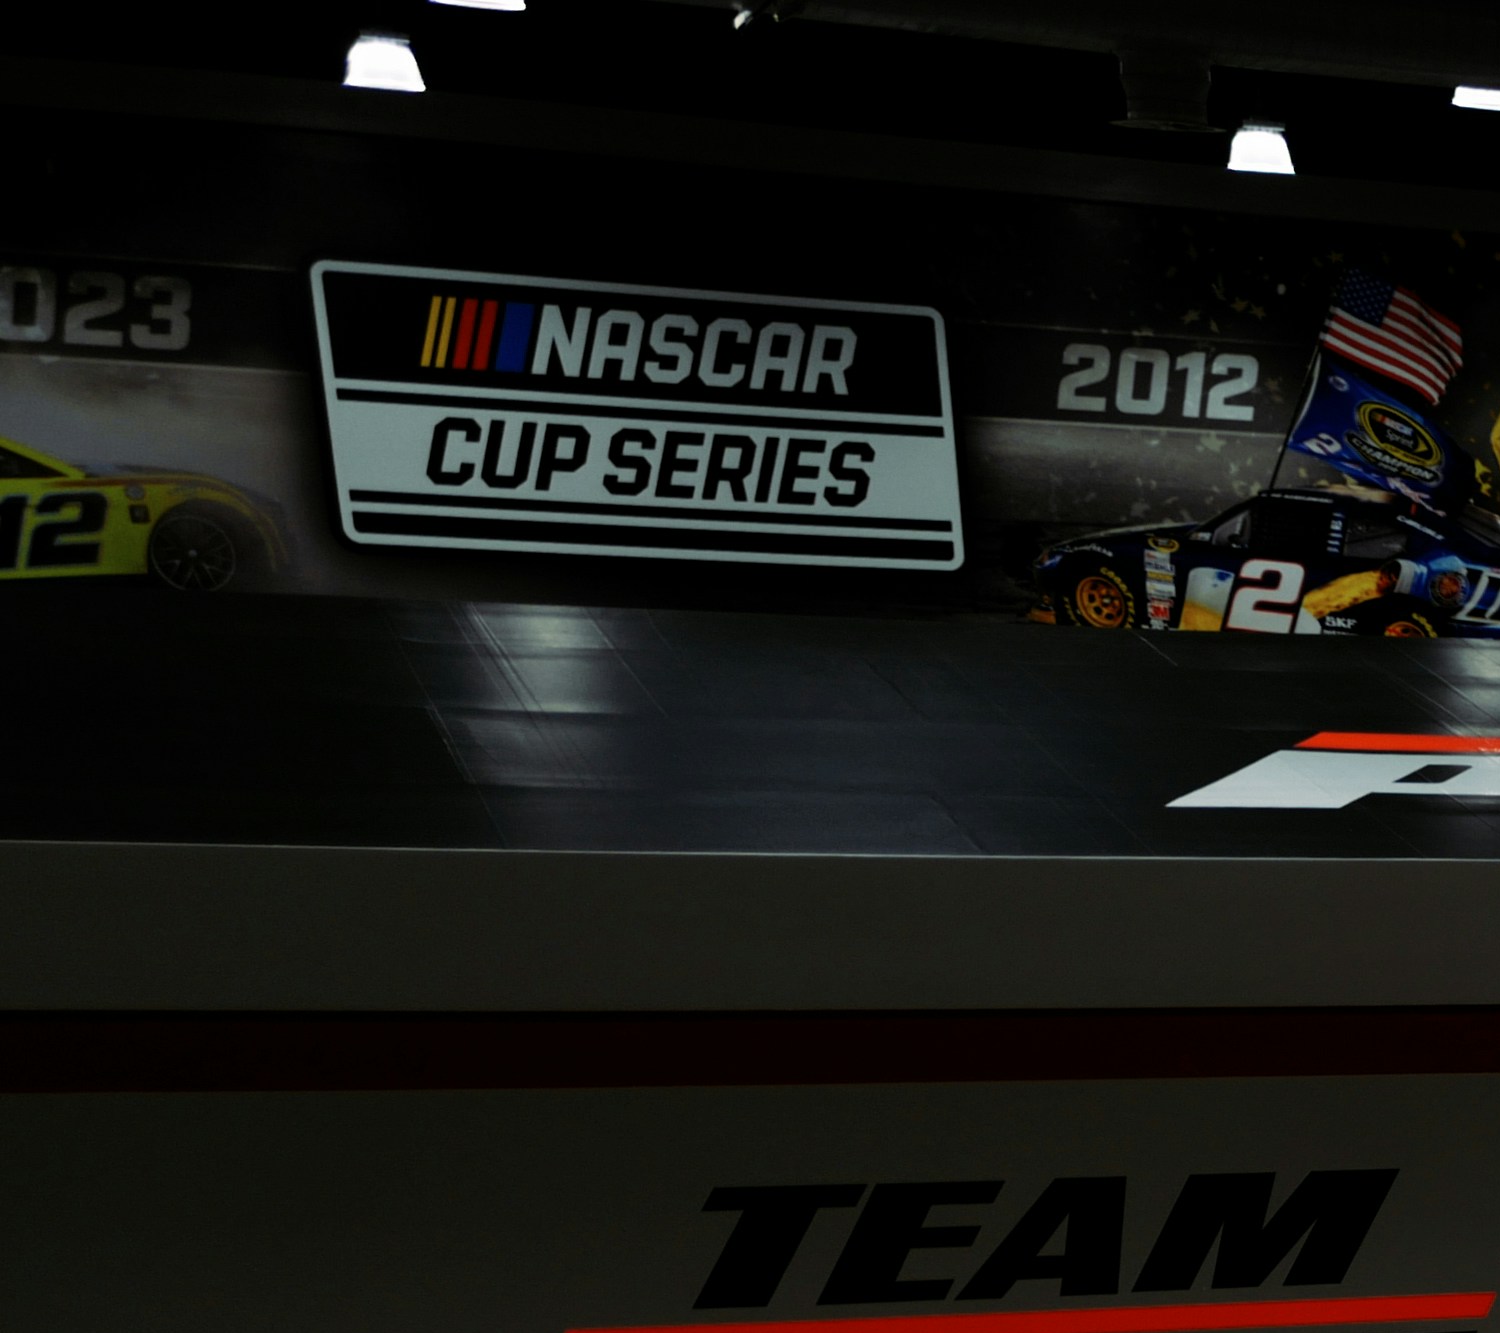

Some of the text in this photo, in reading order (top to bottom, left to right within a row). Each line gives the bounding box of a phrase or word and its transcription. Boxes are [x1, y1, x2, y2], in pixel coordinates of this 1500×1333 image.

[531, 302, 859, 396] NASCAR
[1056, 343, 1260, 422] 2012
[426, 416, 875, 507] CUP SERIES
[1303, 432, 1343, 456] 2
[1350, 437, 1435, 481] CHAMPION
[1225, 558, 1306, 634] 2
[1323, 615, 1359, 629] SKF
[693, 1168, 1399, 1309] TEAM
